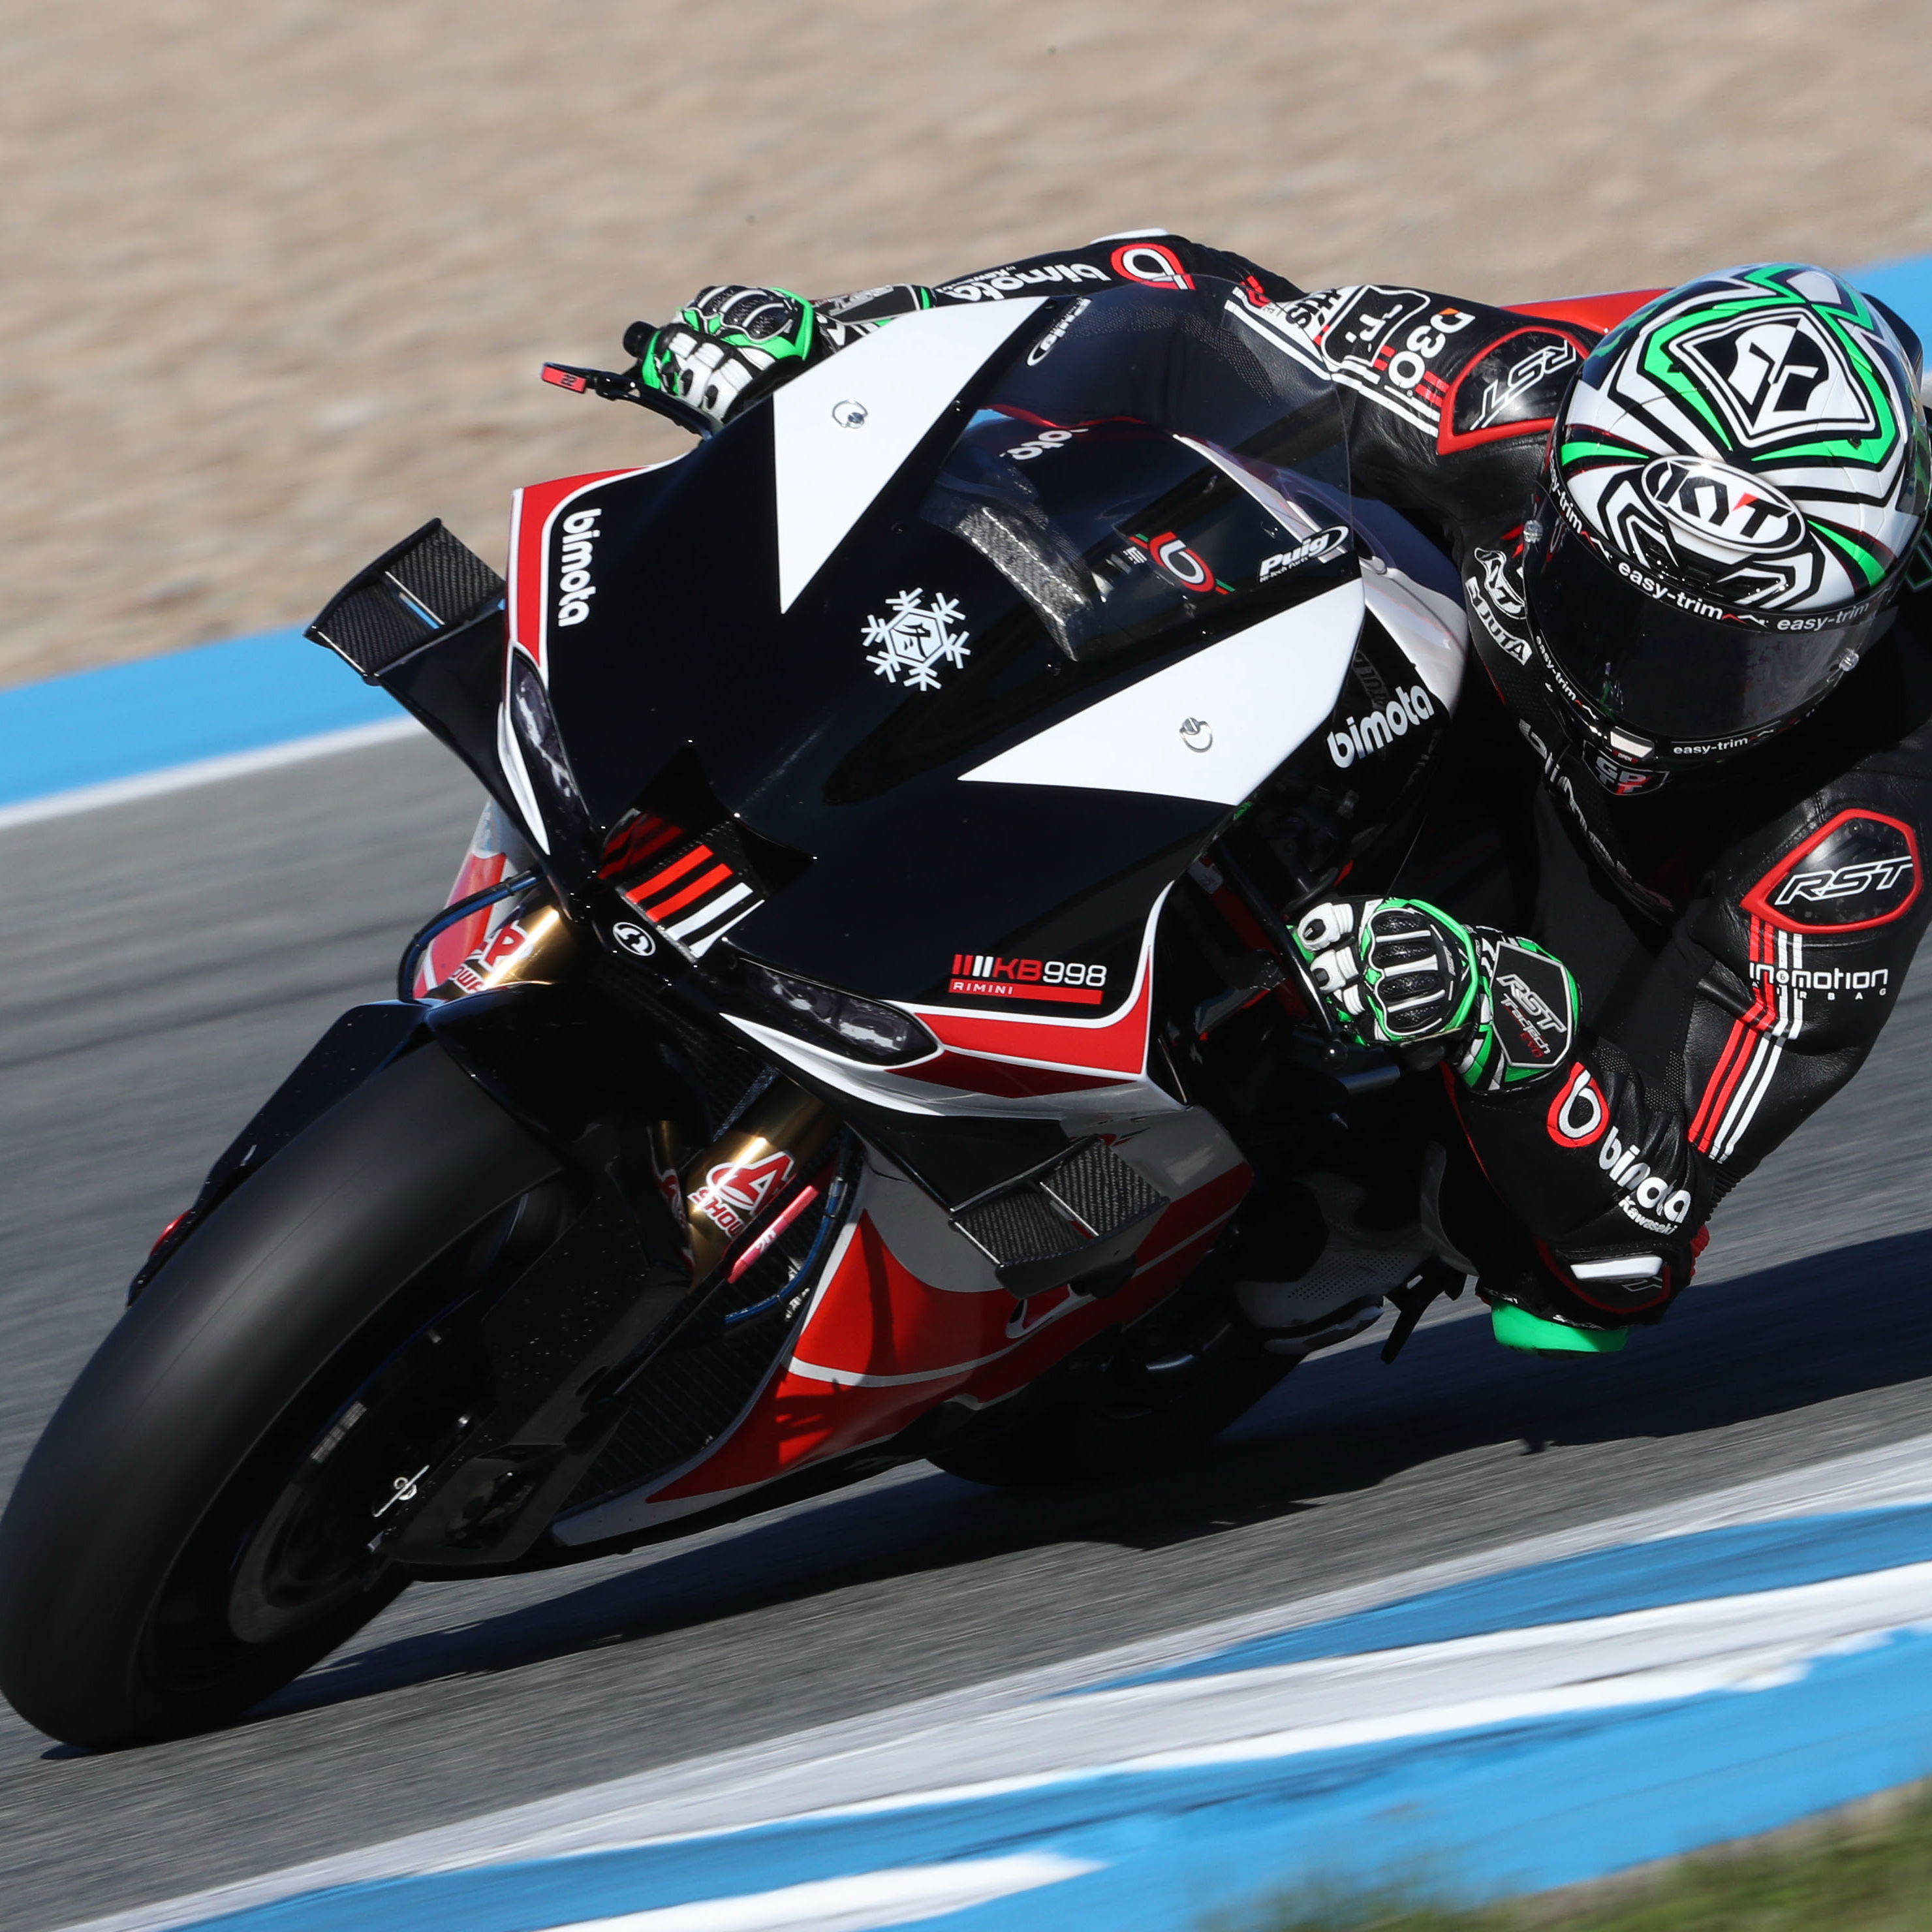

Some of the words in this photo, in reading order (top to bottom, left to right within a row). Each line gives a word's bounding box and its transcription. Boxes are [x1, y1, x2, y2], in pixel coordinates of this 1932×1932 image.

[945, 263, 1112, 302] bimota
[1470, 340, 1576, 431] RST
[1645, 458, 1794, 539] KYT
[558, 508, 601, 627] bimota
[1260, 533, 1330, 577] Puig
[1618, 561, 1723, 621] easy-trim
[1777, 603, 1869, 631] easy-trim
[1536, 636, 1576, 700] easy-trim
[1327, 685, 1435, 768] bimota
[1674, 737, 1748, 755] easy-trim
[1774, 856, 1912, 905] RST
[952, 982, 1014, 995] RIMINI
[1496, 973, 1566, 1033] RST
[1619, 1196, 1677, 1235] Kawasaki
